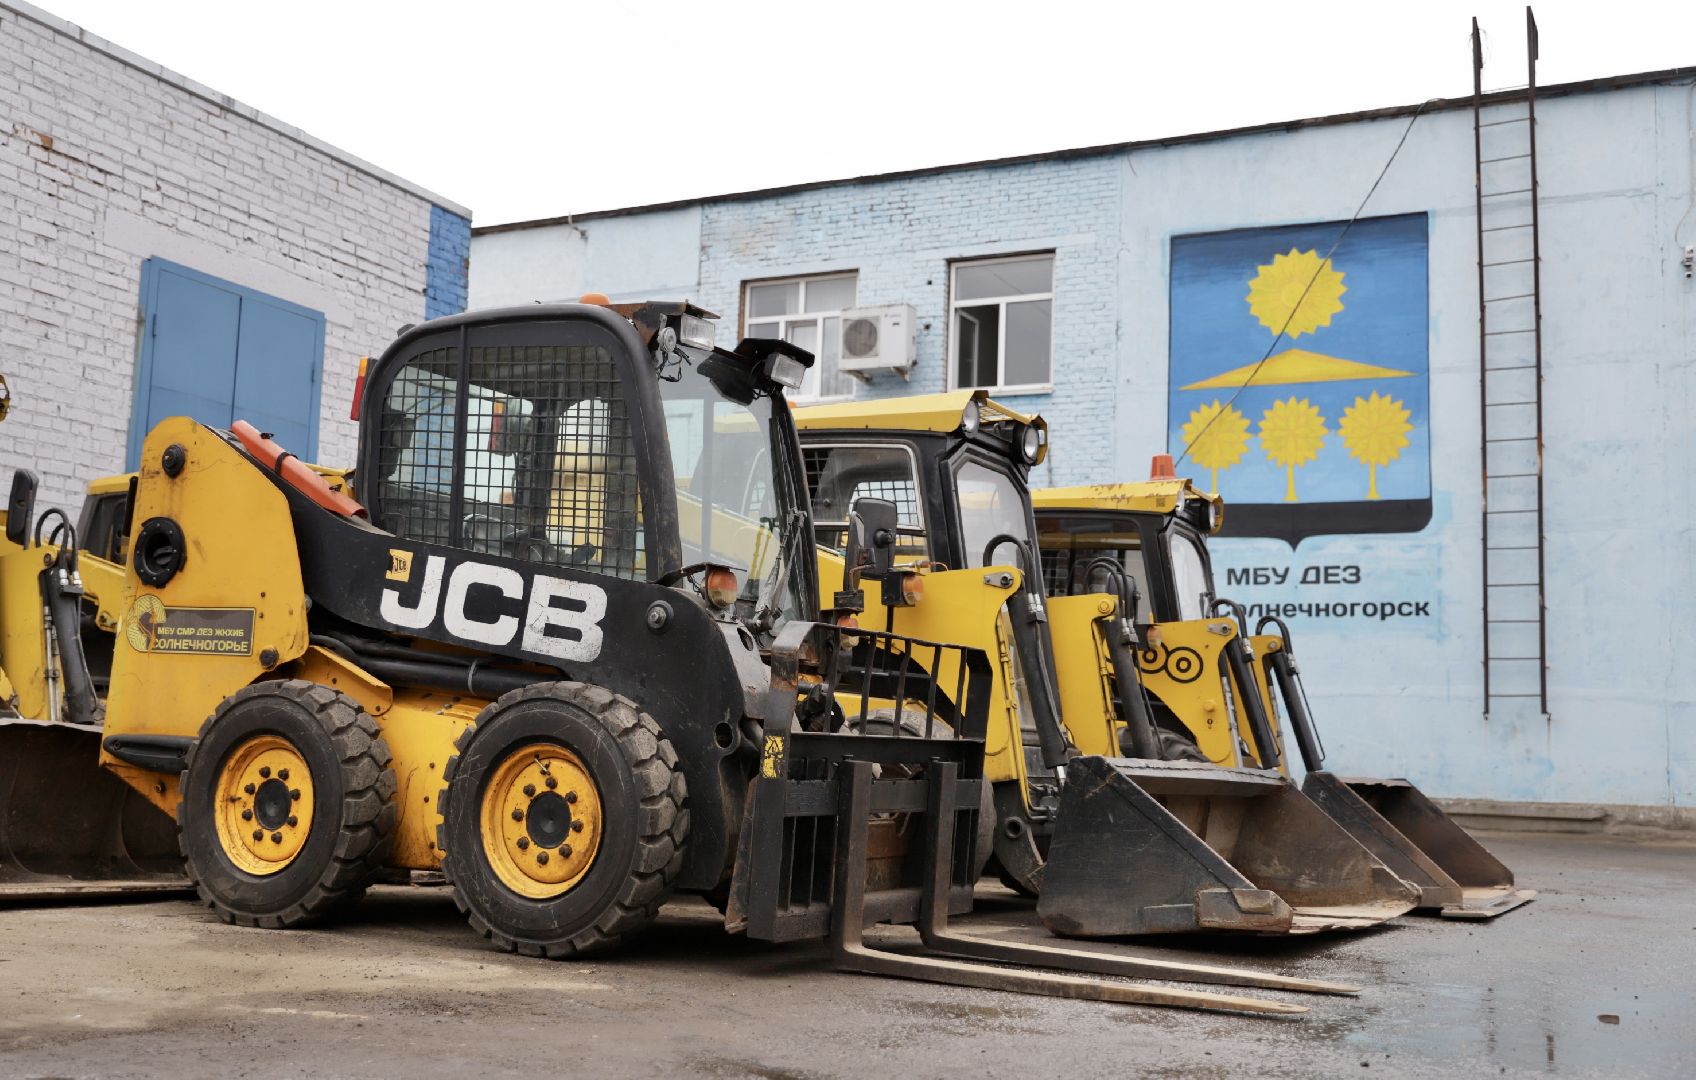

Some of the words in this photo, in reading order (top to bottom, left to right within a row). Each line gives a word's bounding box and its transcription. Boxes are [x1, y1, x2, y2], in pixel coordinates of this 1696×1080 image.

[394, 557, 407, 572] JCB
[1227, 567, 1290, 585] МБУ
[1299, 565, 1361, 584] ДЕЗ
[380, 555, 608, 663] JCB
[157, 627, 175, 635] МБУ
[176, 627, 195, 635] СМР
[196, 628, 213, 636] ДЕЗ
